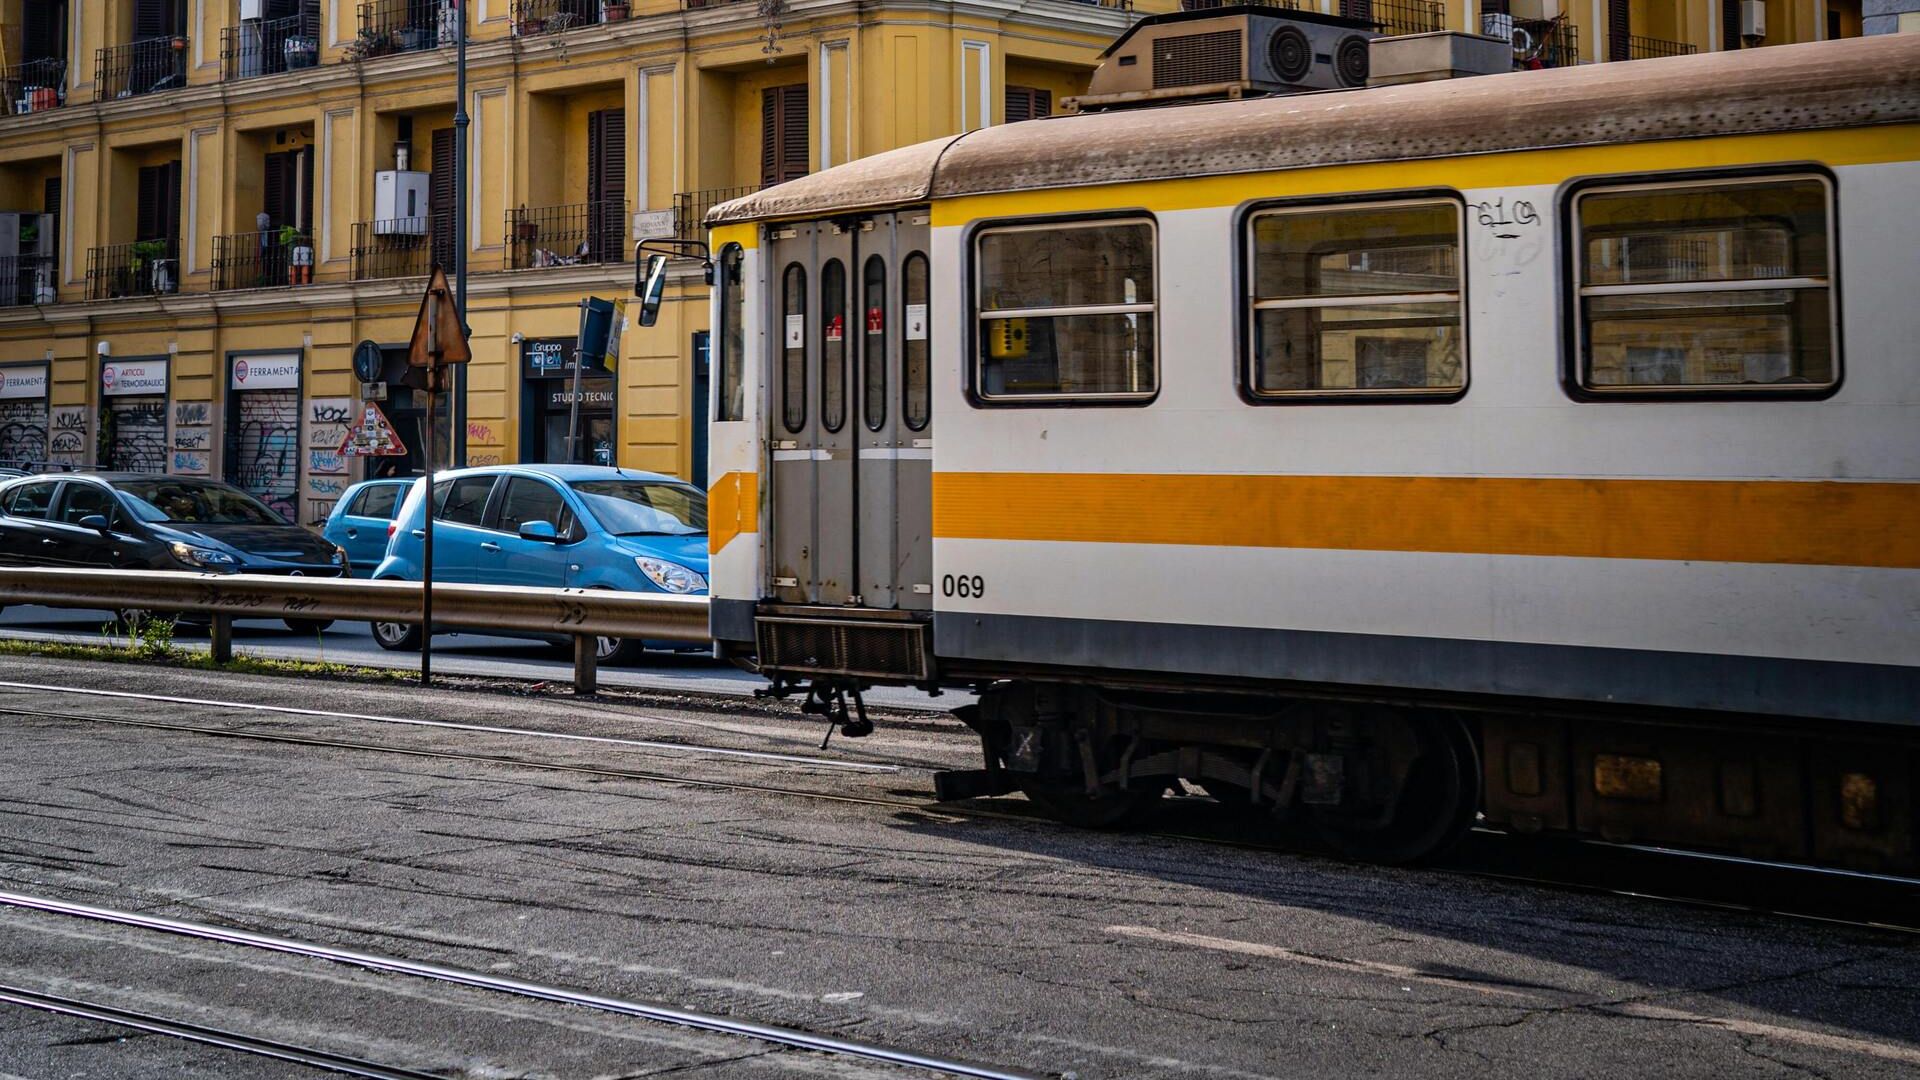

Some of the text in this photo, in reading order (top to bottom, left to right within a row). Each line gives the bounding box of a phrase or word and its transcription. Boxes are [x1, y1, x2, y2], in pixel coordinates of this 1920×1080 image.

[534, 342, 562, 353] Gruppo
[250, 366, 300, 377] FERRAMENTA
[552, 392, 583, 402] STUDO
[942, 574, 984, 599] 069
